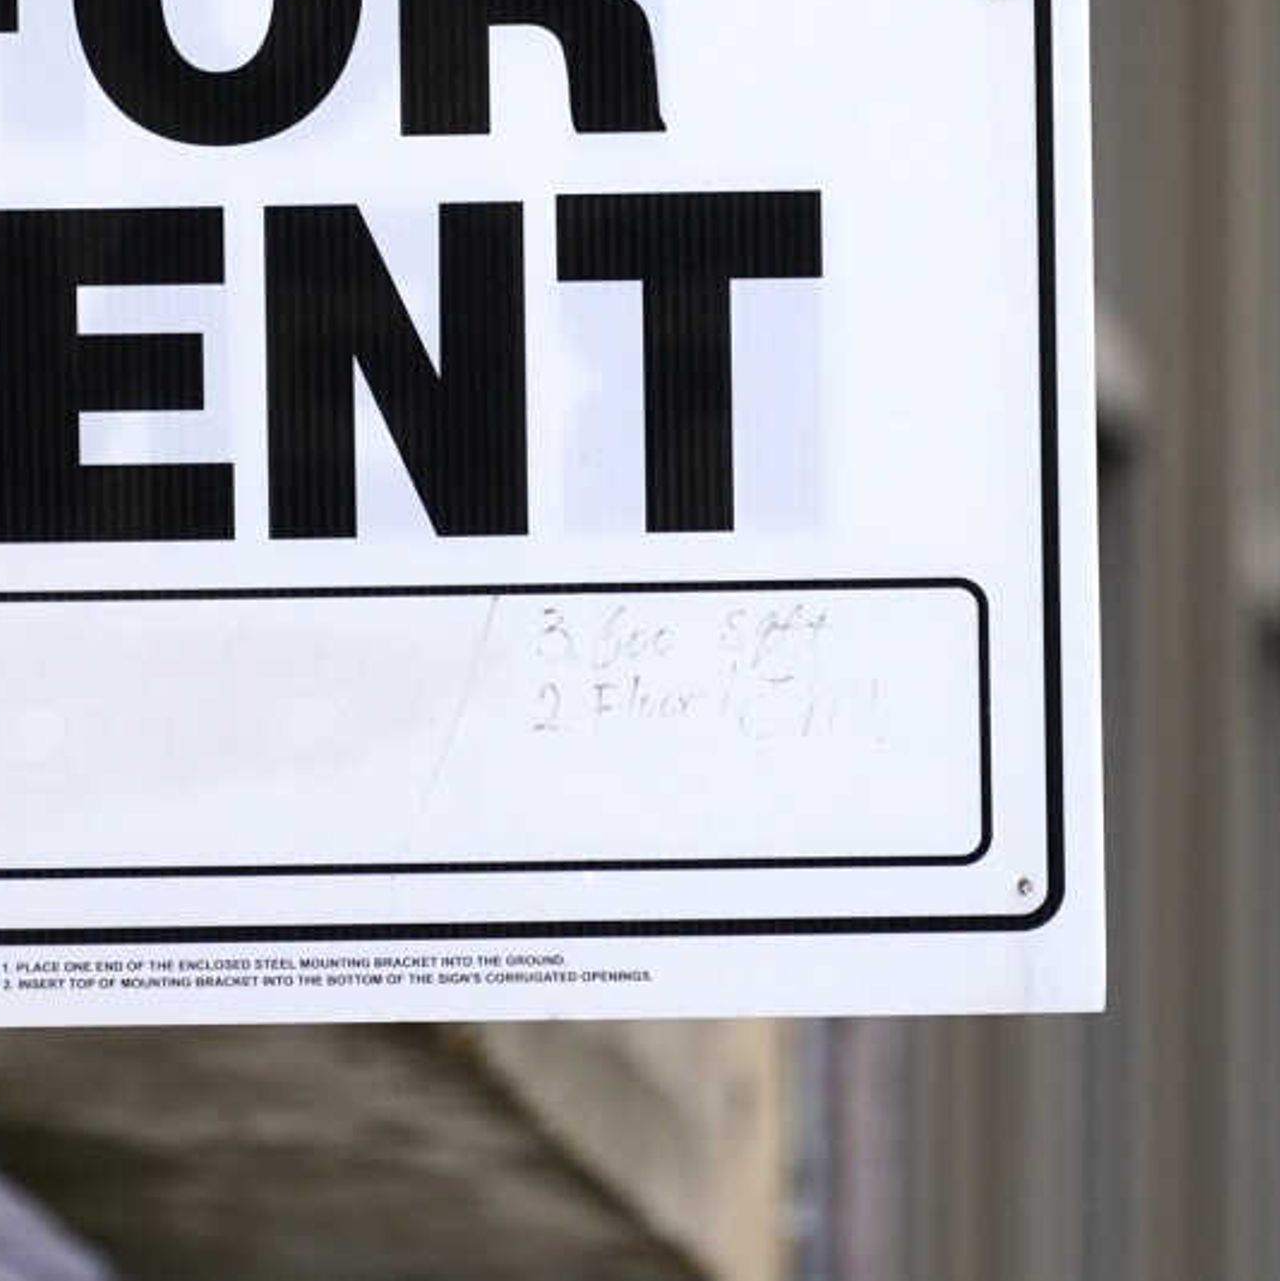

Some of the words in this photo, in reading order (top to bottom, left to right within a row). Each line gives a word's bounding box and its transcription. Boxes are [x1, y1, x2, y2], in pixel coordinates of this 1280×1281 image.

[534, 682, 563, 731] 2
[16, 961, 60, 973] PLACE
[64, 960, 93, 972] ONE
[95, 960, 123, 972] END
[126, 959, 144, 972] OF
[149, 959, 174, 971] THE
[179, 958, 250, 971] ENCLOSED
[254, 957, 296, 970] STEEL
[300, 956, 370, 969] MOUNTING
[373, 955, 437, 968] BRACKET
[440, 955, 473, 967] INTO
[477, 954, 501, 967] THE
[18, 977, 65, 990] INSERT
[69, 976, 95, 989] TOP
[98, 976, 116, 989] OF
[121, 975, 192, 988] MOUNTING
[195, 974, 258, 987] BRACKET
[262, 974, 294, 987] INTO
[298, 973, 322, 986] THE
[326, 973, 383, 986] BOTTOM
[386, 972, 404, 985] OF
[408, 972, 433, 985] THE
